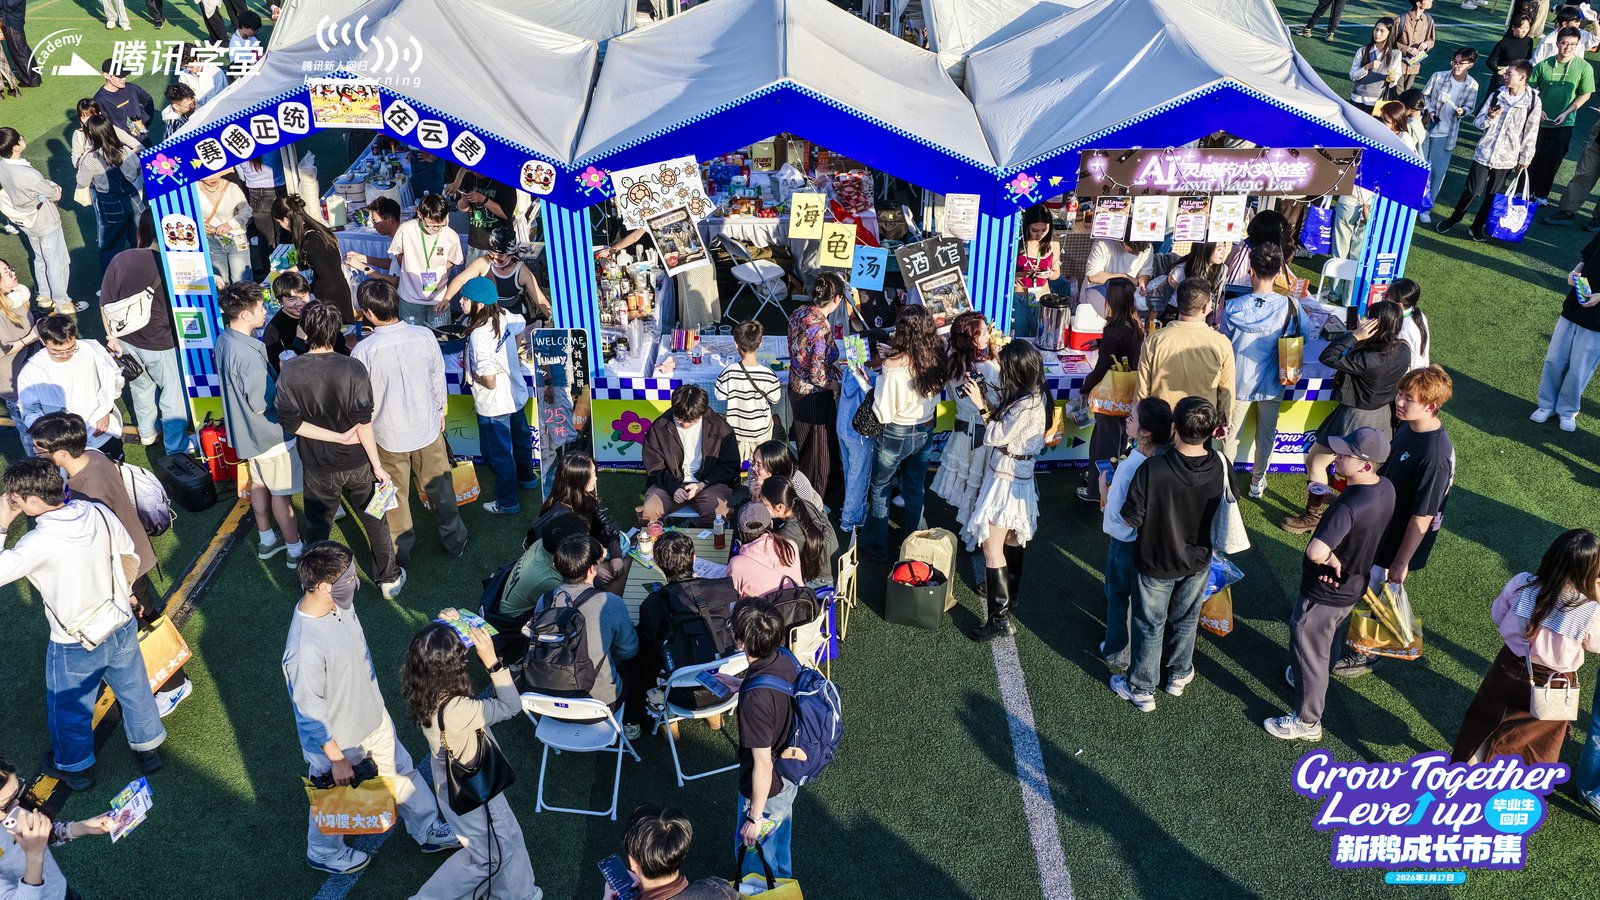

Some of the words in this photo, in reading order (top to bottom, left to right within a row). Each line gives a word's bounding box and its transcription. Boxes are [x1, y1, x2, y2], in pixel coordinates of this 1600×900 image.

[197, 106, 306, 165] 赛博正统
[387, 104, 481, 162] 在云贵
[1218, 177, 1264, 195] Magic
[1266, 178, 1295, 191] Bar
[902, 242, 961, 278] 酒馆
[535, 336, 584, 346] WELCOME
[543, 408, 567, 424] 25
[1275, 432, 1304, 442] row
